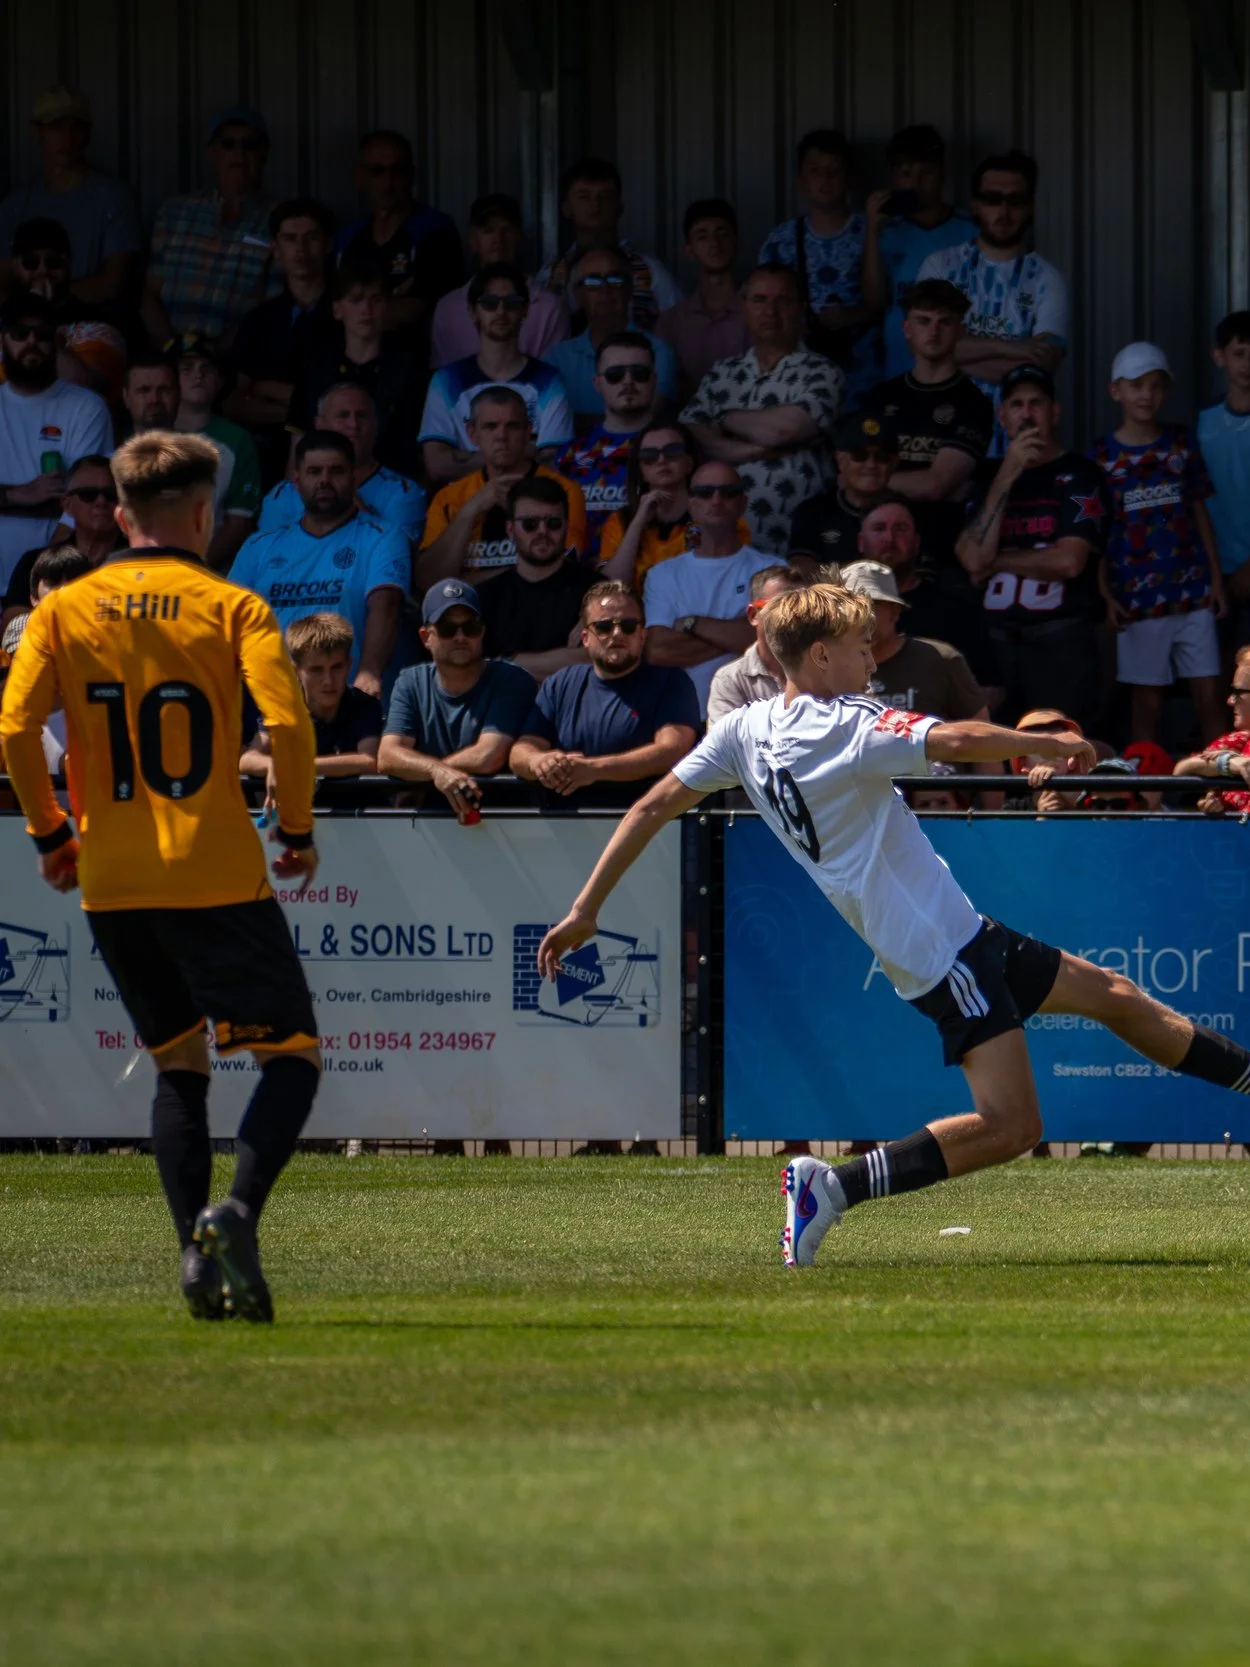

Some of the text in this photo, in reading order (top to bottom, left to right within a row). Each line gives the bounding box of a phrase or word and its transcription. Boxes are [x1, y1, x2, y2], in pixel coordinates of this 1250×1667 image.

[270, 578, 344, 597] BROOKS
[126, 594, 181, 621] Hill
[87, 681, 213, 802] 10
[336, 886, 359, 907] By
[320, 924, 340, 956] &
[350, 924, 436, 956] SONS
[371, 988, 491, 1005] Cambridgeshire
[96, 1031, 126, 1049] Tel:
[348, 1032, 412, 1050] 01954
[419, 1032, 496, 1050] 234967
[1053, 1063, 1111, 1076] Sawston
[1114, 1063, 1151, 1077] CB22
